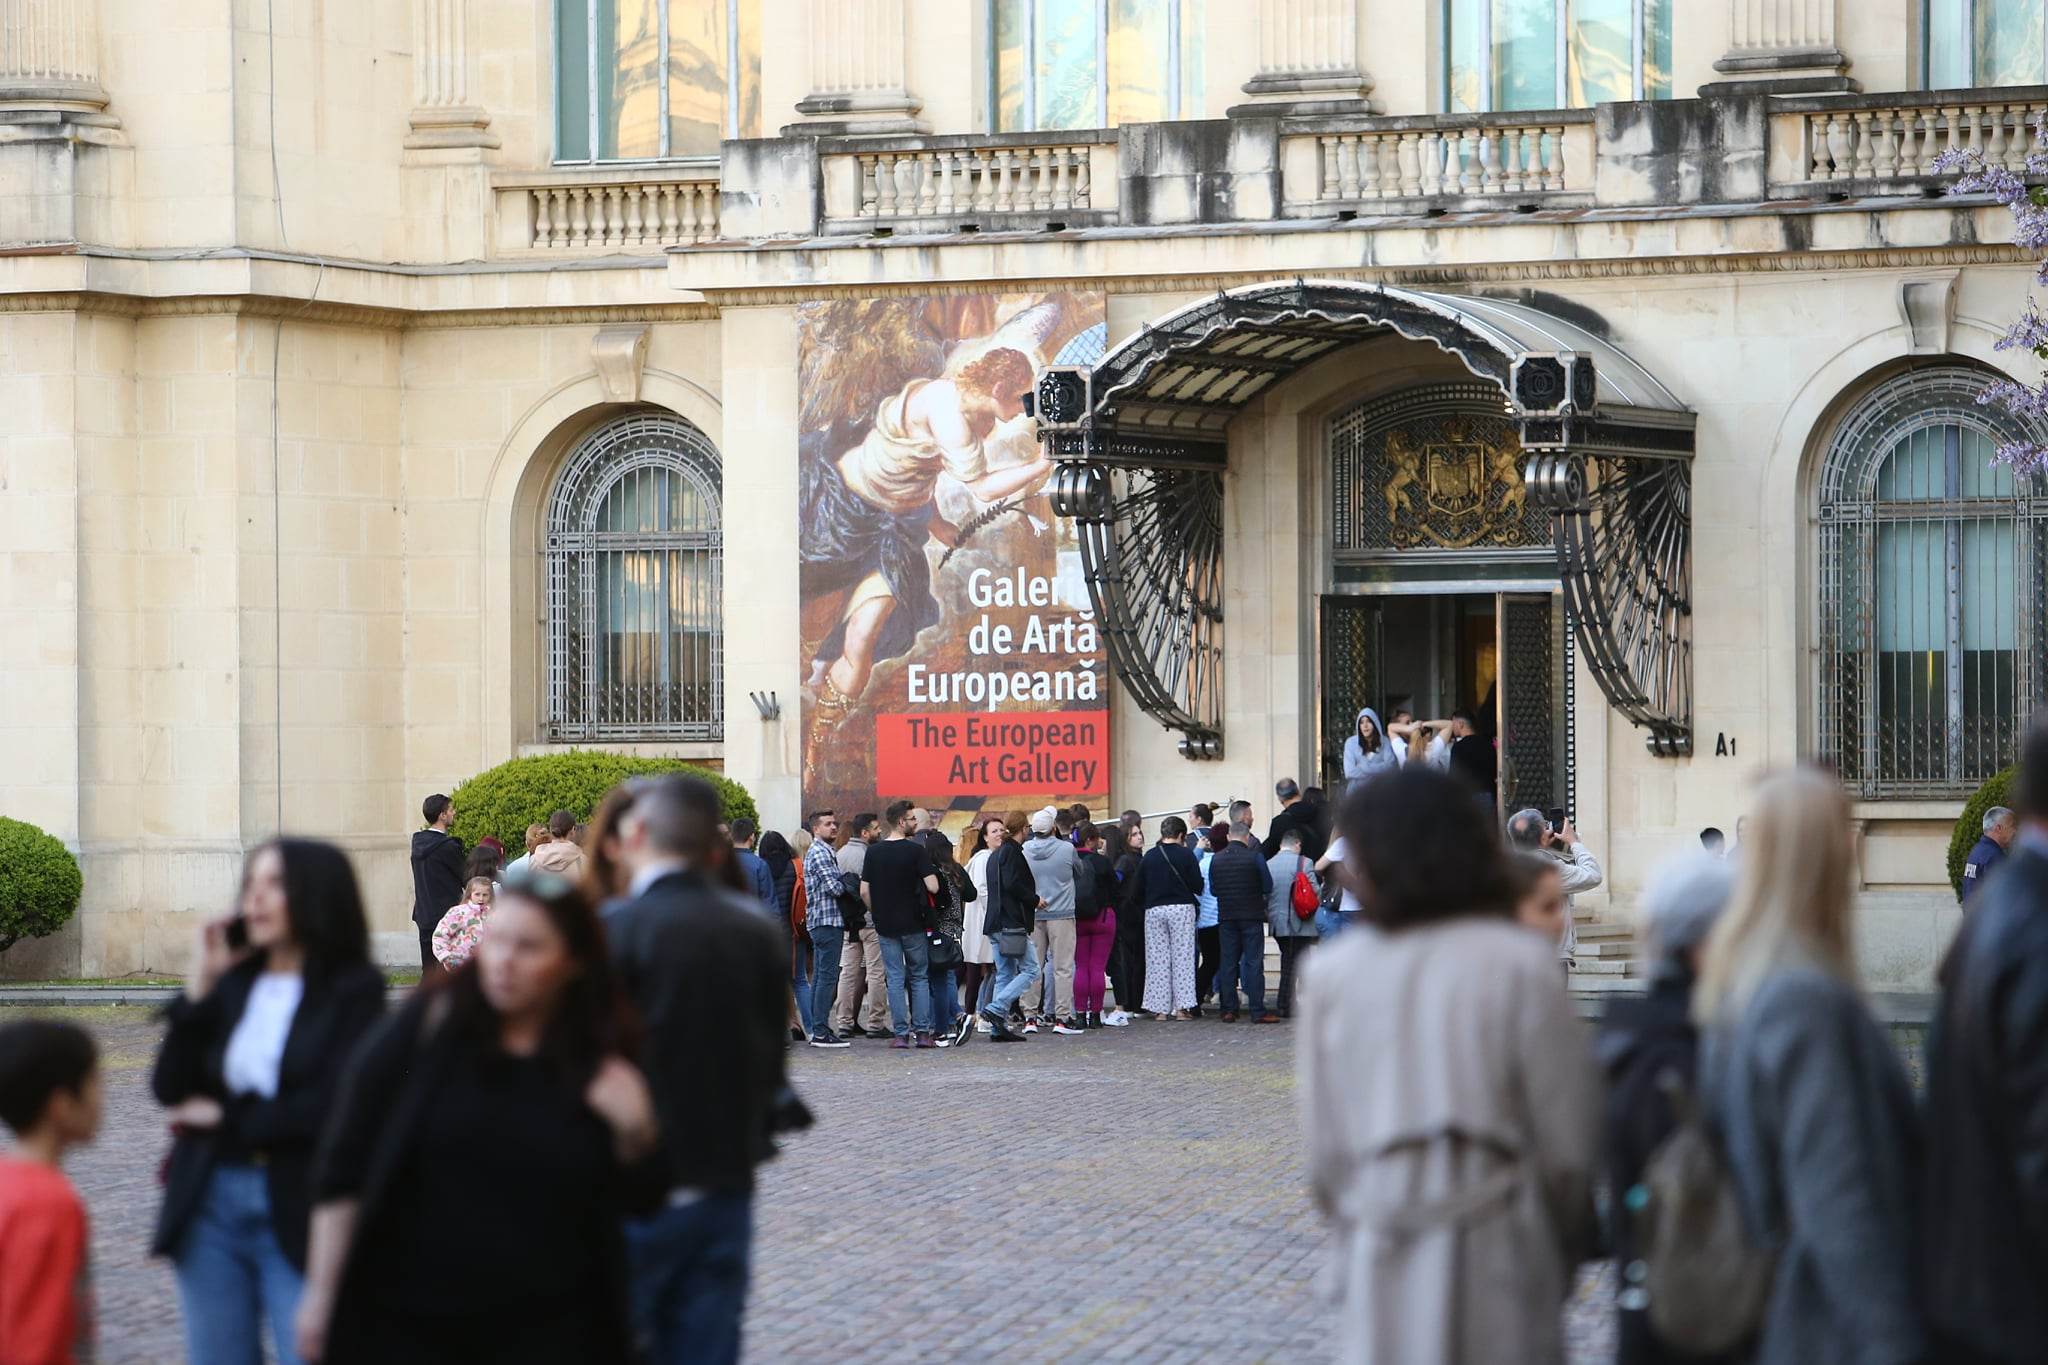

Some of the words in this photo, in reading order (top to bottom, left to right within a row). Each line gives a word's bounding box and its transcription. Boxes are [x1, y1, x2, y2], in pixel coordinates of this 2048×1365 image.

[968, 566, 1066, 608] Galer
[968, 614, 1012, 655] de
[1021, 610, 1097, 654] Artă
[908, 658, 1097, 712] Europeană
[907, 718, 957, 747] The
[966, 718, 1095, 754] European
[1715, 732, 1736, 757] A1
[948, 755, 989, 784] Art
[998, 753, 1097, 790] Gallery
